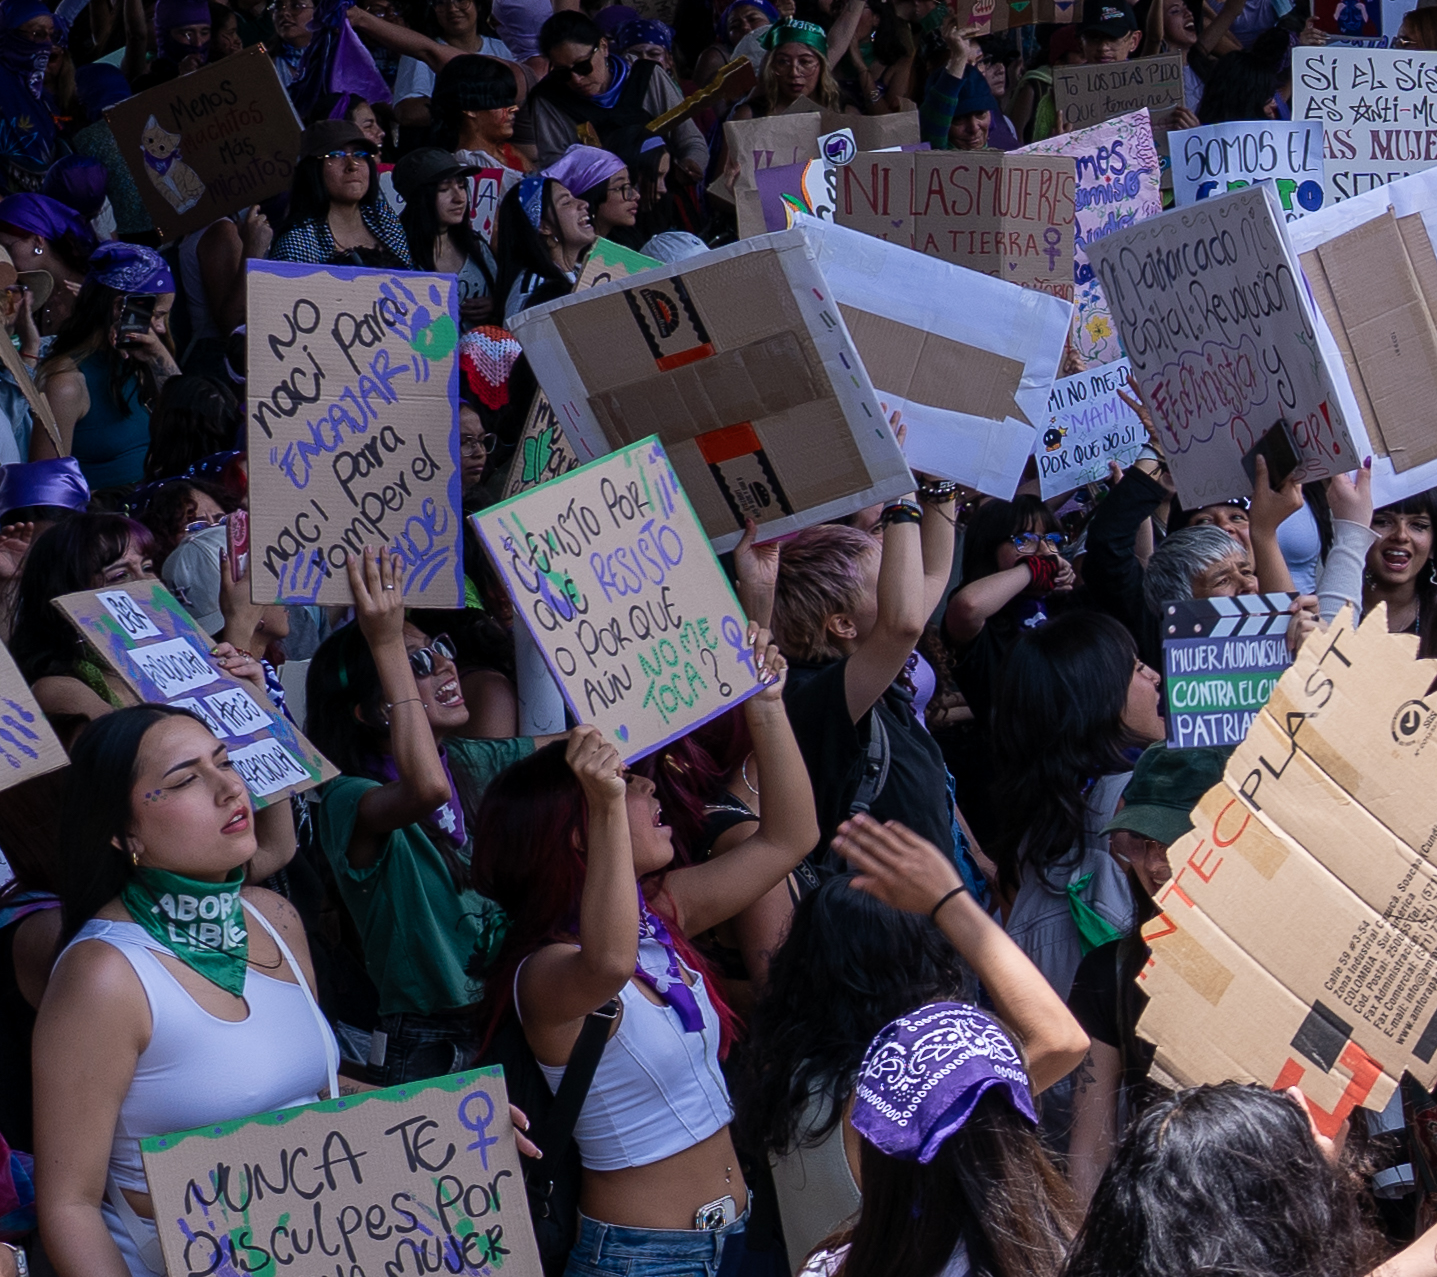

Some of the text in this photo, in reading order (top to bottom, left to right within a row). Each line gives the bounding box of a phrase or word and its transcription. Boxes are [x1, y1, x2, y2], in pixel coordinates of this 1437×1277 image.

[1183, 129, 1320, 183] SOMOS EL
[842, 162, 1077, 228] NI LAS MUJERES
[265, 296, 324, 364] NO
[553, 585, 684, 677] O POR QUE
[582, 615, 719, 718] AÚN NO ME
[640, 660, 709, 726] TOCA
[1170, 678, 1258, 709] CONTRA EL
[1237, 626, 1354, 814] PLAST
[1341, 930, 1394, 1008] COLOMBIA Sur
[1364, 957, 1391, 997] Postal:
[1372, 960, 1420, 1032] Fax Comercial:
[1362, 1005, 1379, 1024] Fax
[183, 1113, 457, 1217] NUNCA TE
